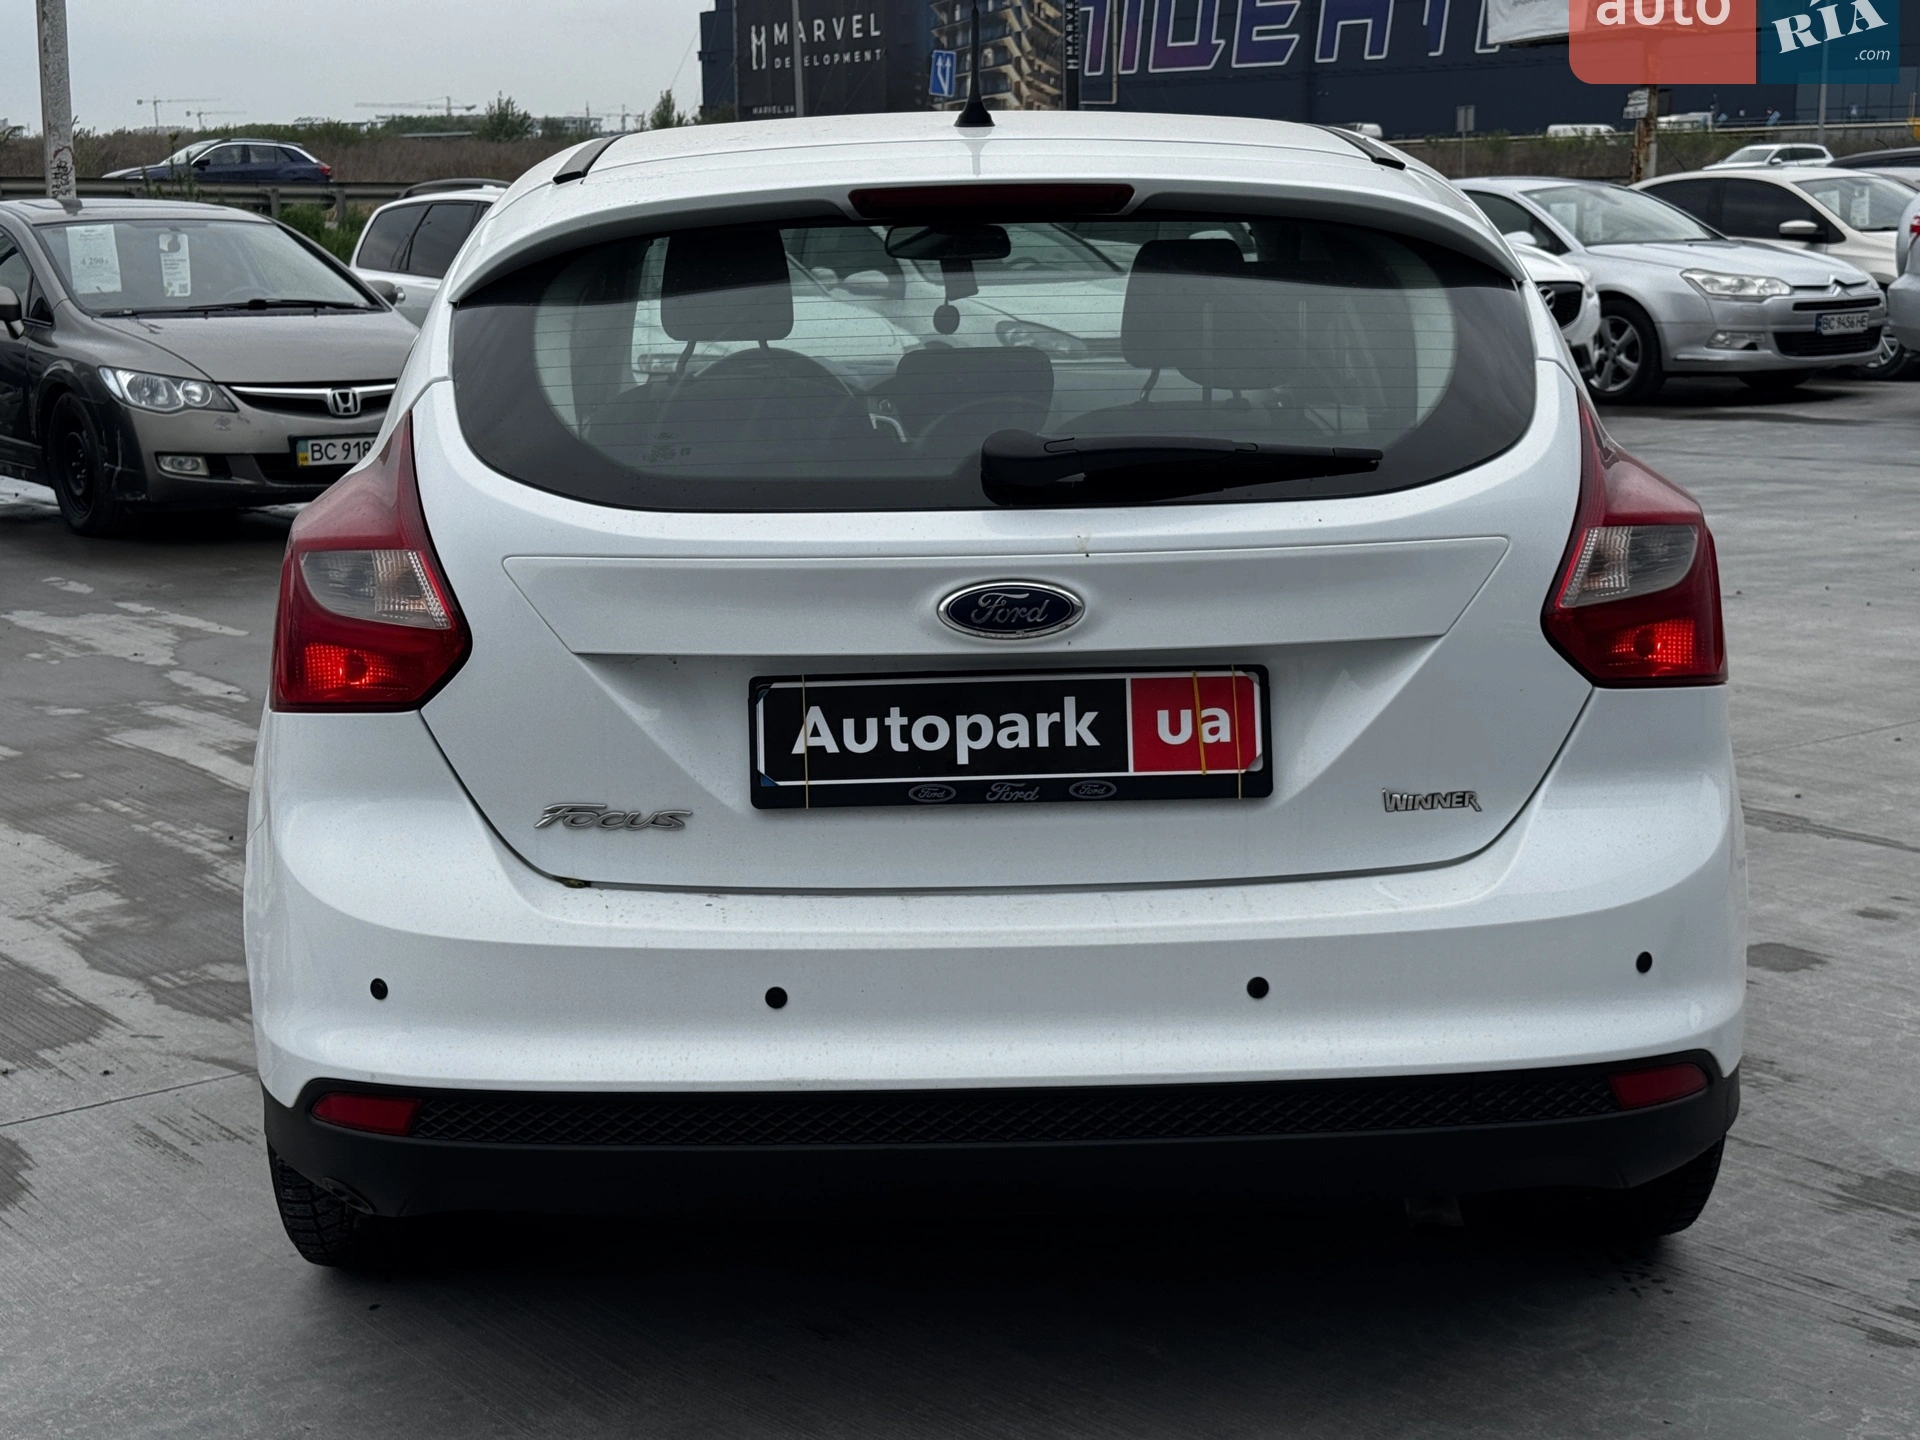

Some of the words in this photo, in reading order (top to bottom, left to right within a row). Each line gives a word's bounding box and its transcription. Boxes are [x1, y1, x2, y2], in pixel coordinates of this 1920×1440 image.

[774, 48, 882, 69] DEELOPMENT
[310, 442, 338, 462] BC
[341, 440, 377, 461] 918
[970, 592, 1051, 624] Ford
[791, 696, 1101, 765] Autopark
[1156, 706, 1232, 746] ua
[918, 788, 946, 799] Ford
[985, 781, 1041, 801] Ford
[1078, 784, 1107, 796] Ford
[1381, 788, 1483, 813] WINNER
[534, 803, 694, 831] Focus
